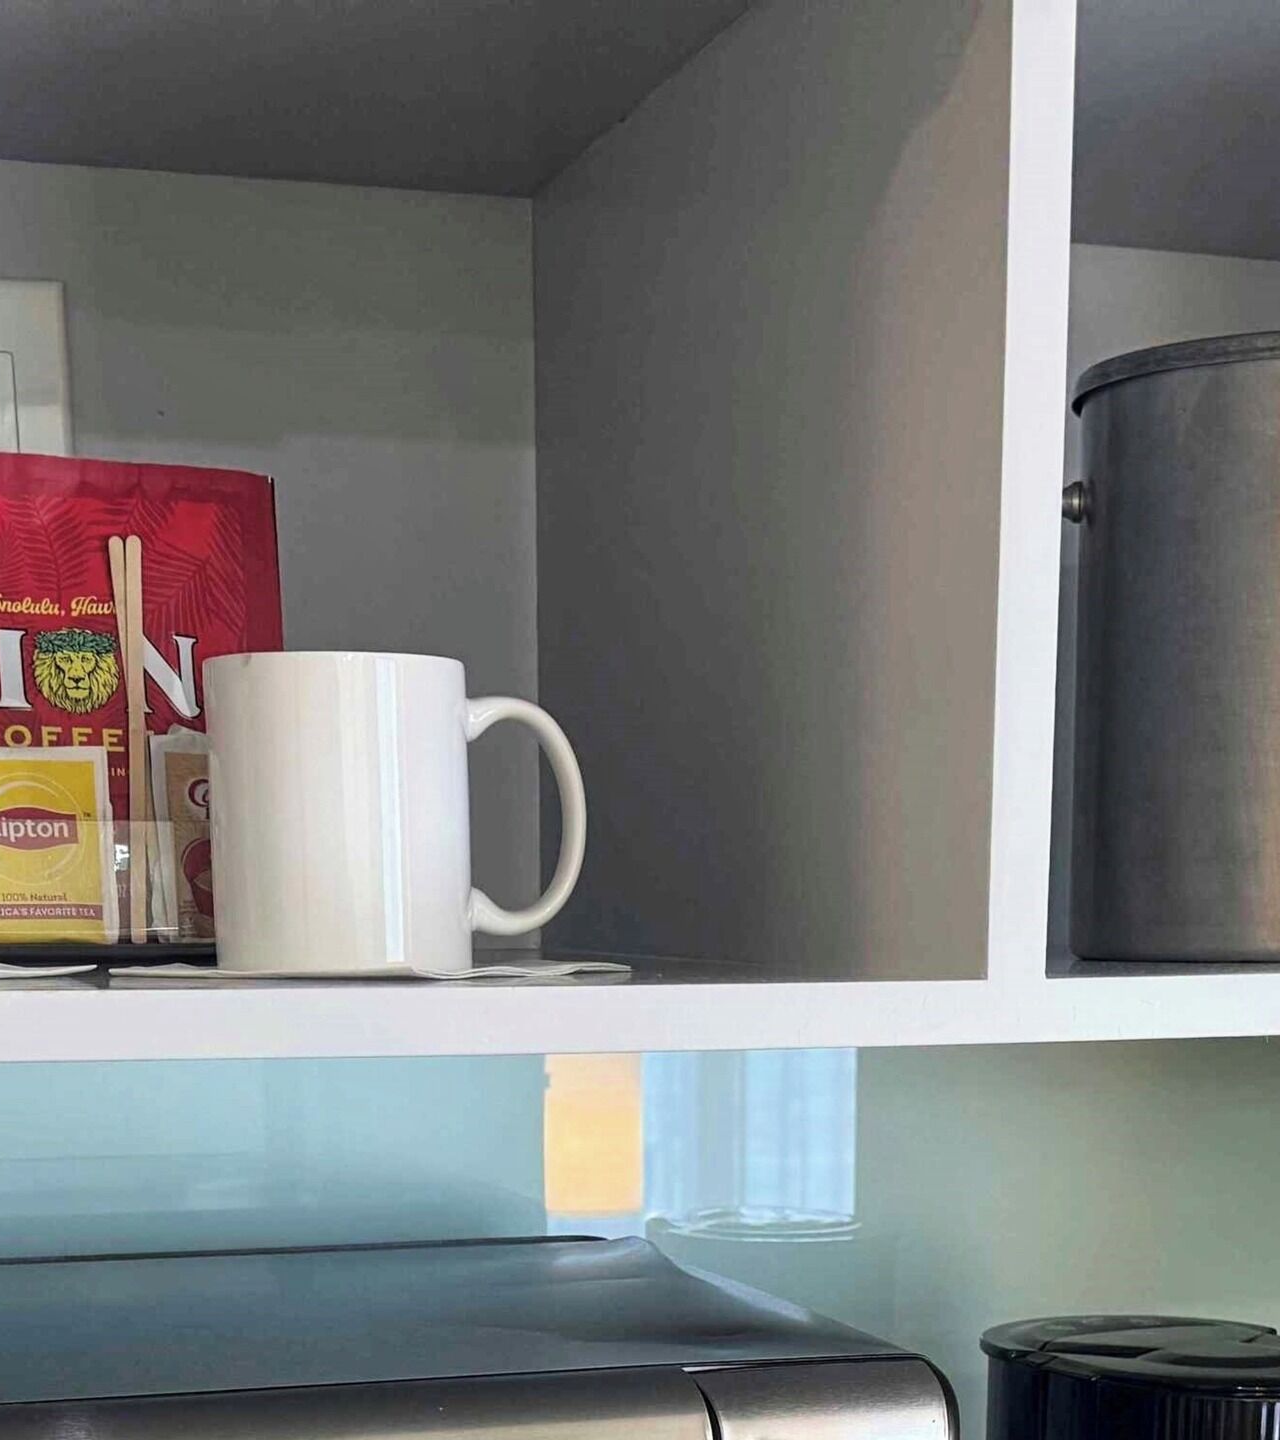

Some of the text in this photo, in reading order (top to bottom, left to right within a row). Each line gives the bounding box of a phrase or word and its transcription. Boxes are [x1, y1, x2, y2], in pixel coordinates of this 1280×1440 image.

[1, 893, 68, 902] 100% Natural
[30, 907, 76, 917] FAVORITE
[78, 908, 96, 917] TEA
